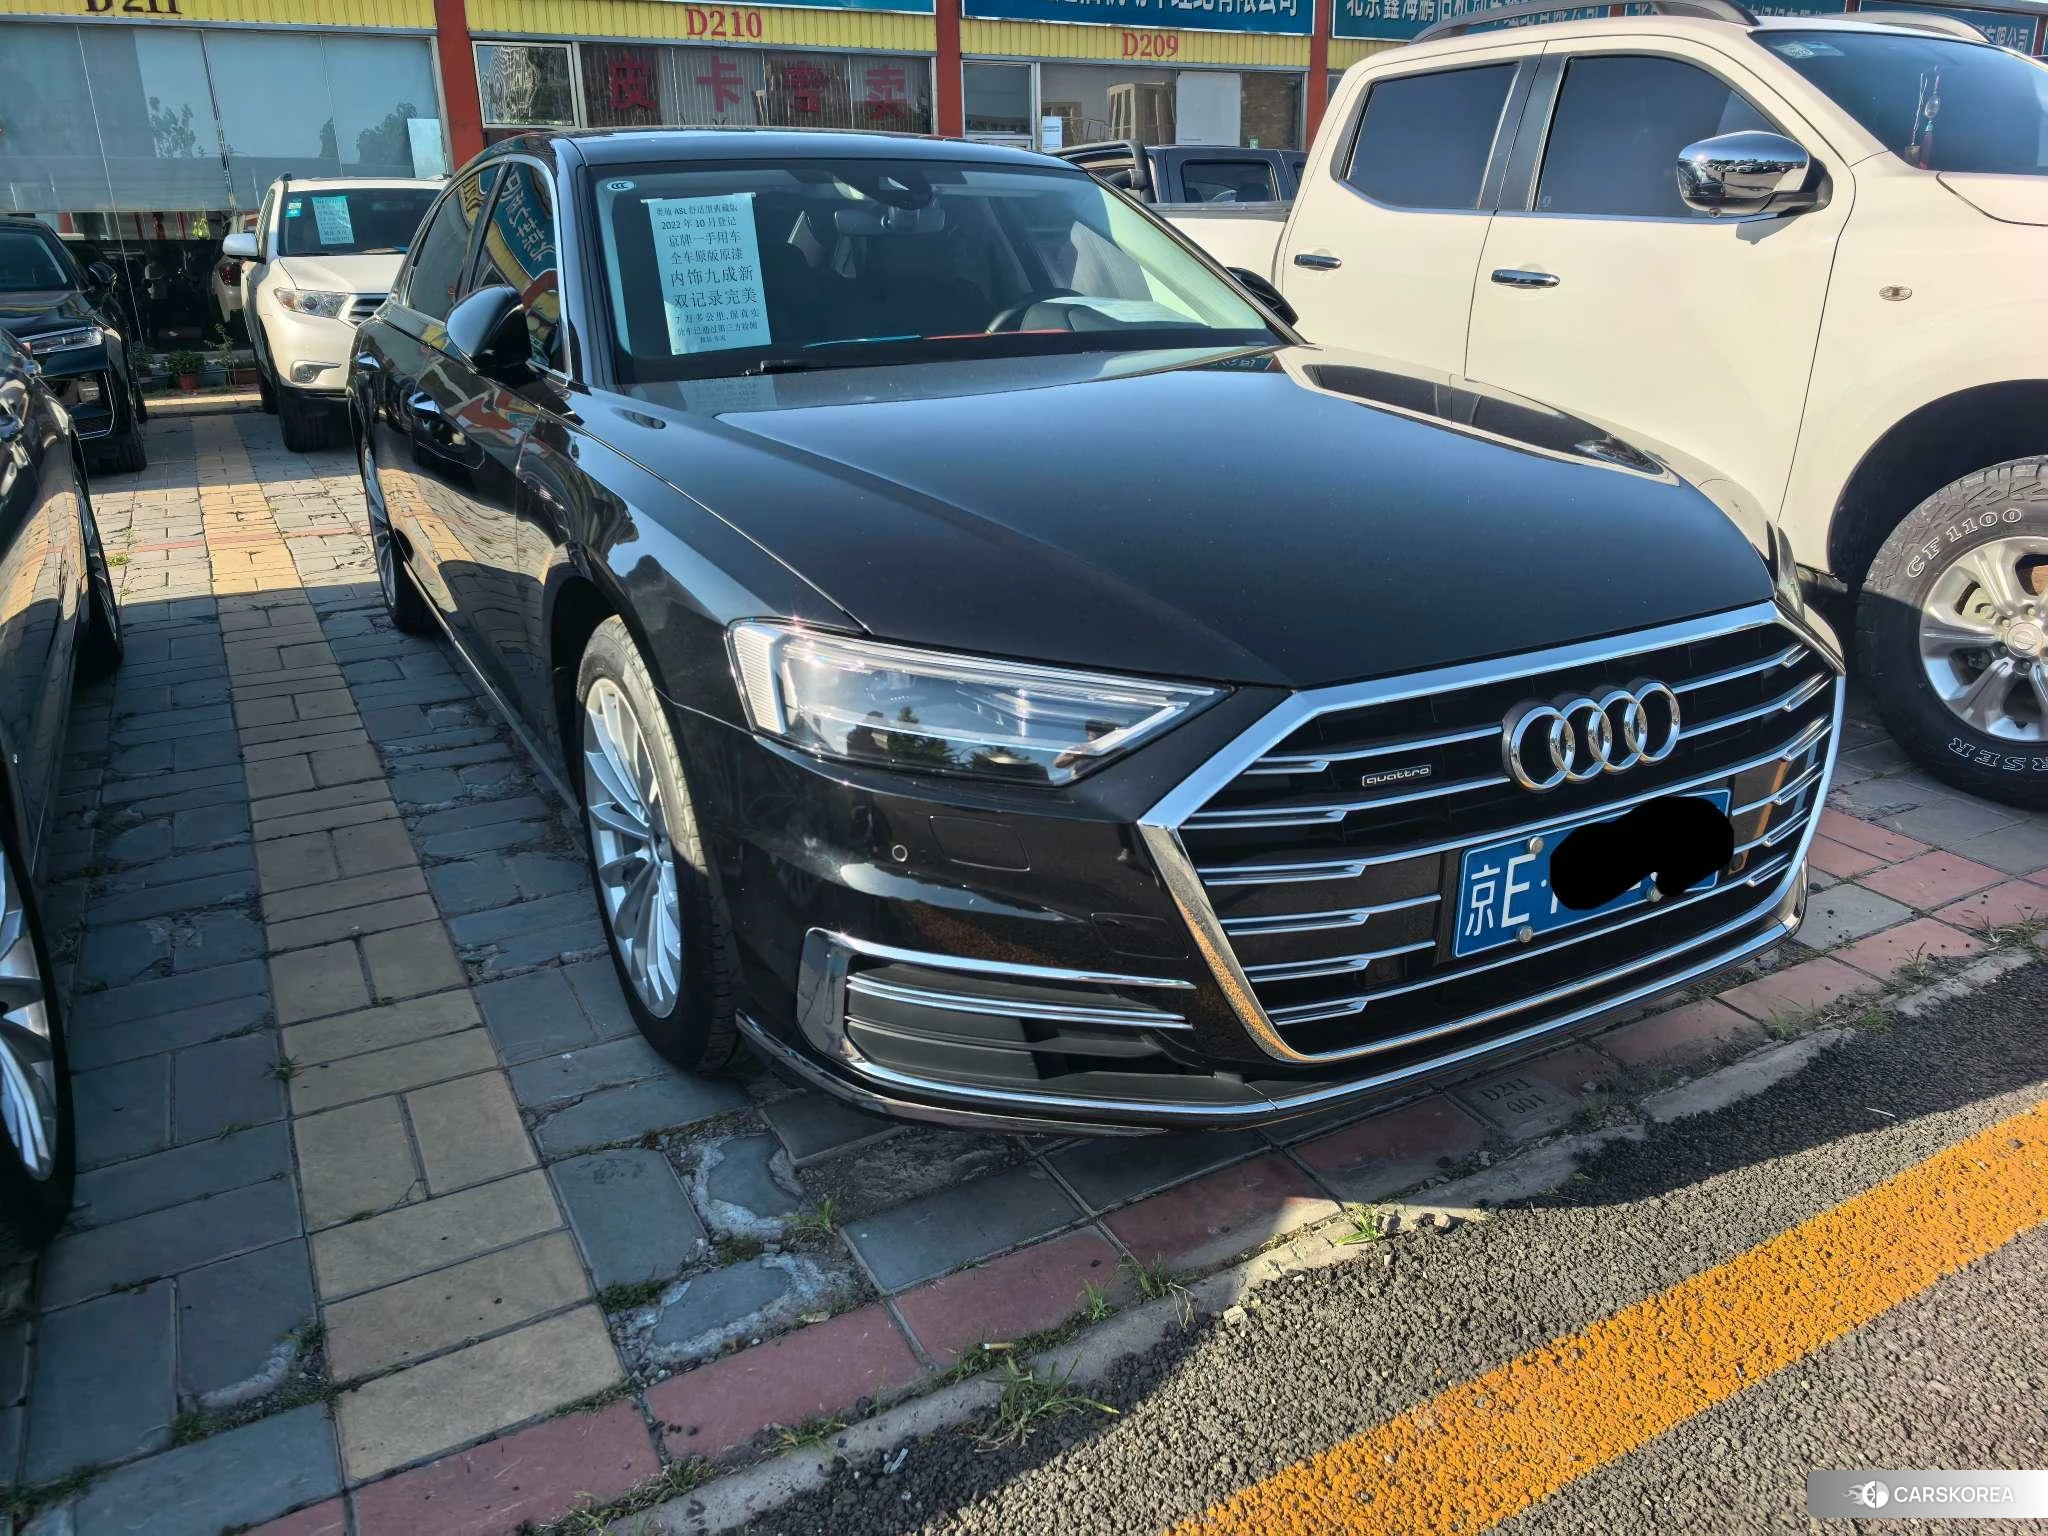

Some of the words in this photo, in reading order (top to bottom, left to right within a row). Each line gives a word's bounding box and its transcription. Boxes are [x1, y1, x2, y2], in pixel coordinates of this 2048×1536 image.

[687, 8, 763, 38] D210
[1122, 32, 1179, 57] D209
[661, 221, 681, 230] 2022
[695, 219, 706, 228] 10
[671, 265, 753, 287] 内饰九成新
[673, 287, 758, 309] 双记录完美
[1366, 767, 1429, 785] quattro
